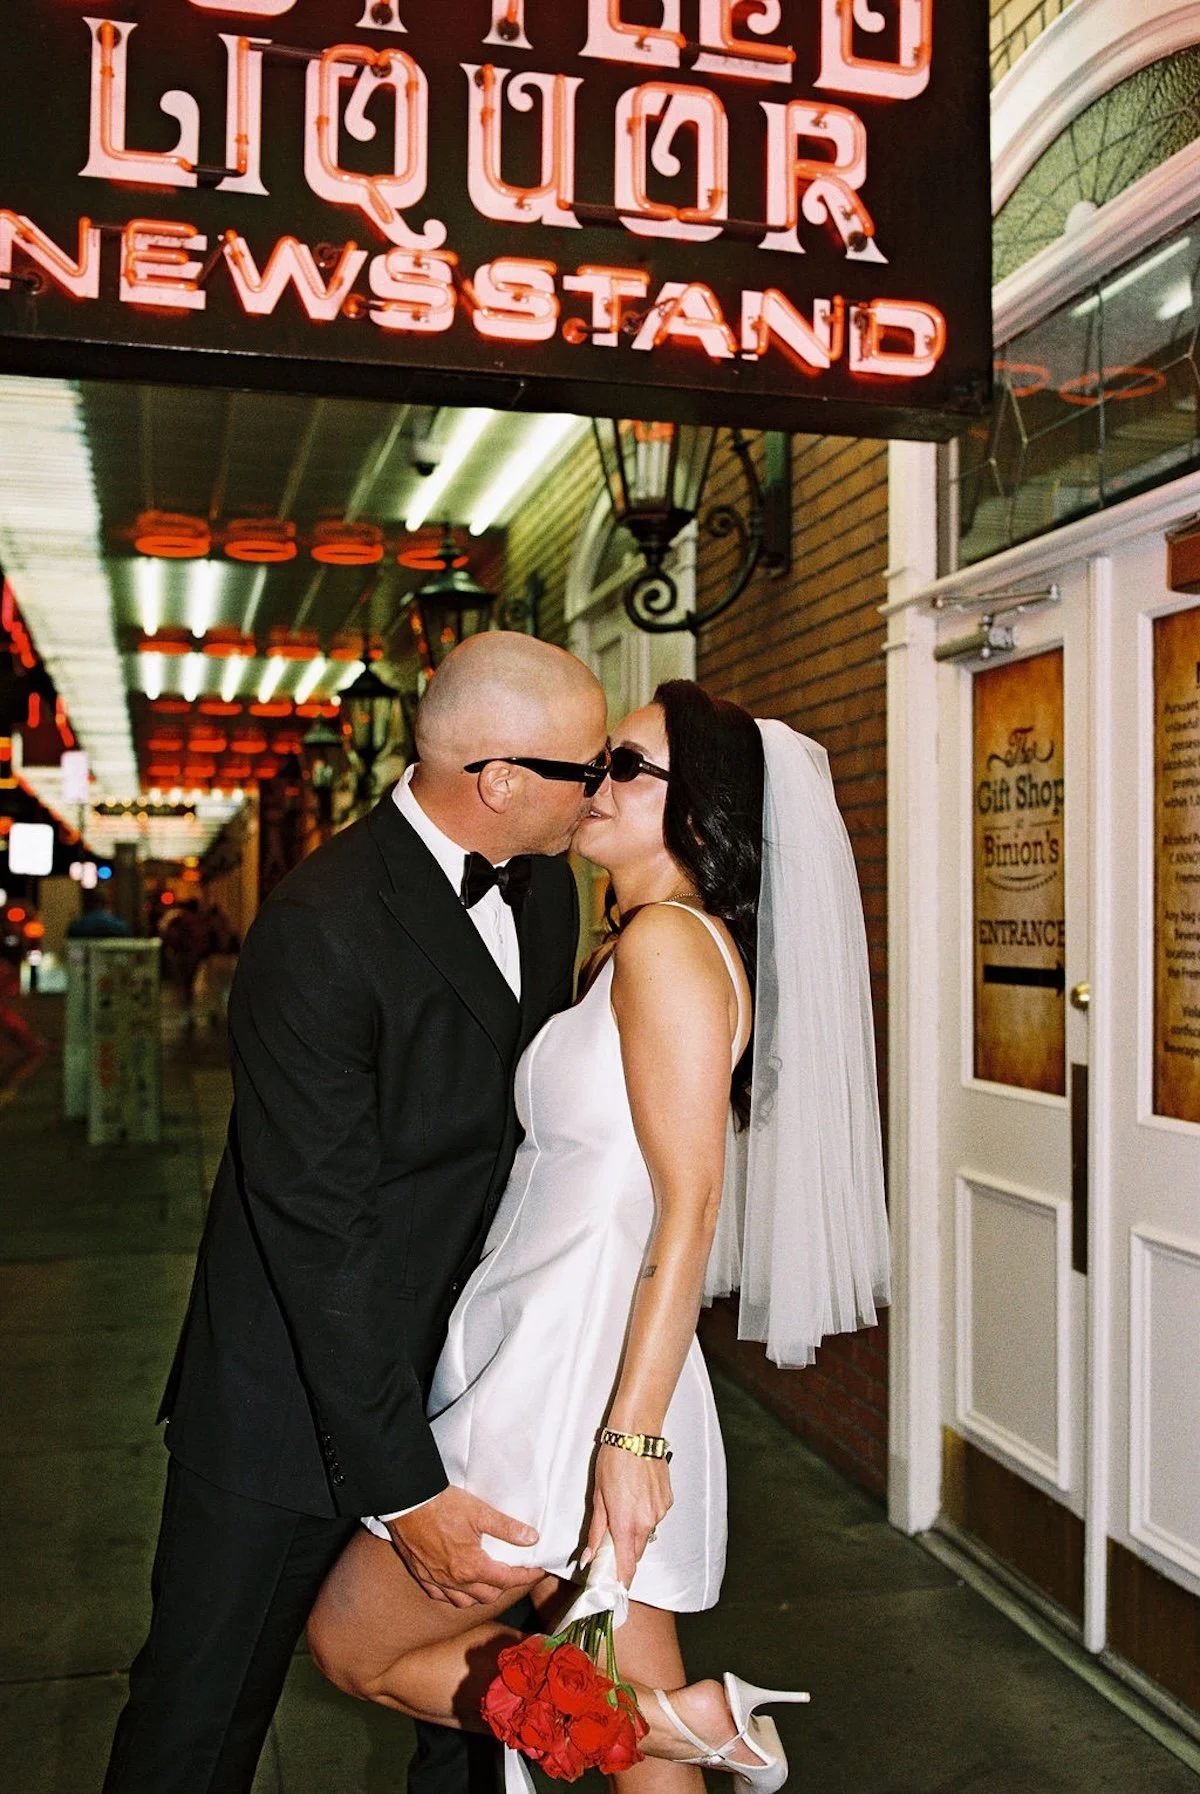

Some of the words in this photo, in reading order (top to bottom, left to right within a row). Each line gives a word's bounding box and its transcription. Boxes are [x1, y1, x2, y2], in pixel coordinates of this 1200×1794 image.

[80, 16, 889, 264] LIQUOR
[0, 209, 946, 378] NEWSSTAND
[977, 778, 1010, 816] Gift
[1015, 773, 1064, 816] Shop
[983, 827, 1060, 868] Binion's
[978, 918, 1065, 948] ENTRANCE
